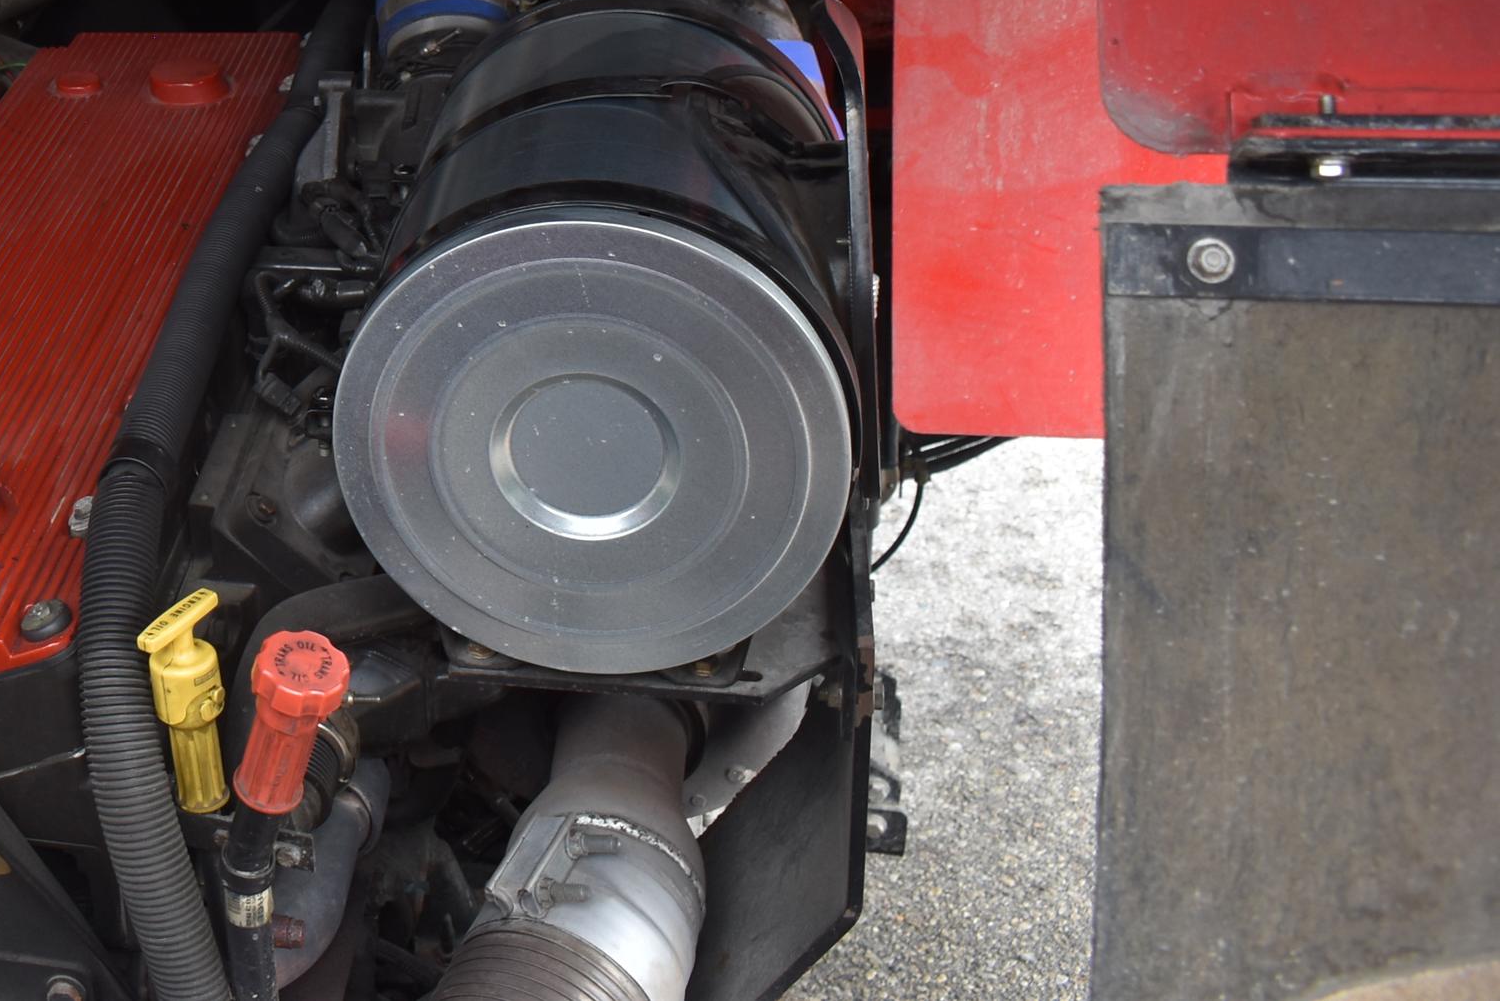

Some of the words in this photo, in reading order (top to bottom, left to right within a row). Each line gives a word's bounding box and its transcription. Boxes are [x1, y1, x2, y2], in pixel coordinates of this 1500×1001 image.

[169, 595, 202, 618] ENGINE
[150, 620, 168, 631] OIL
[274, 643, 293, 667] TRANS
[296, 640, 317, 652] OIL
[314, 655, 333, 680] TRANS
